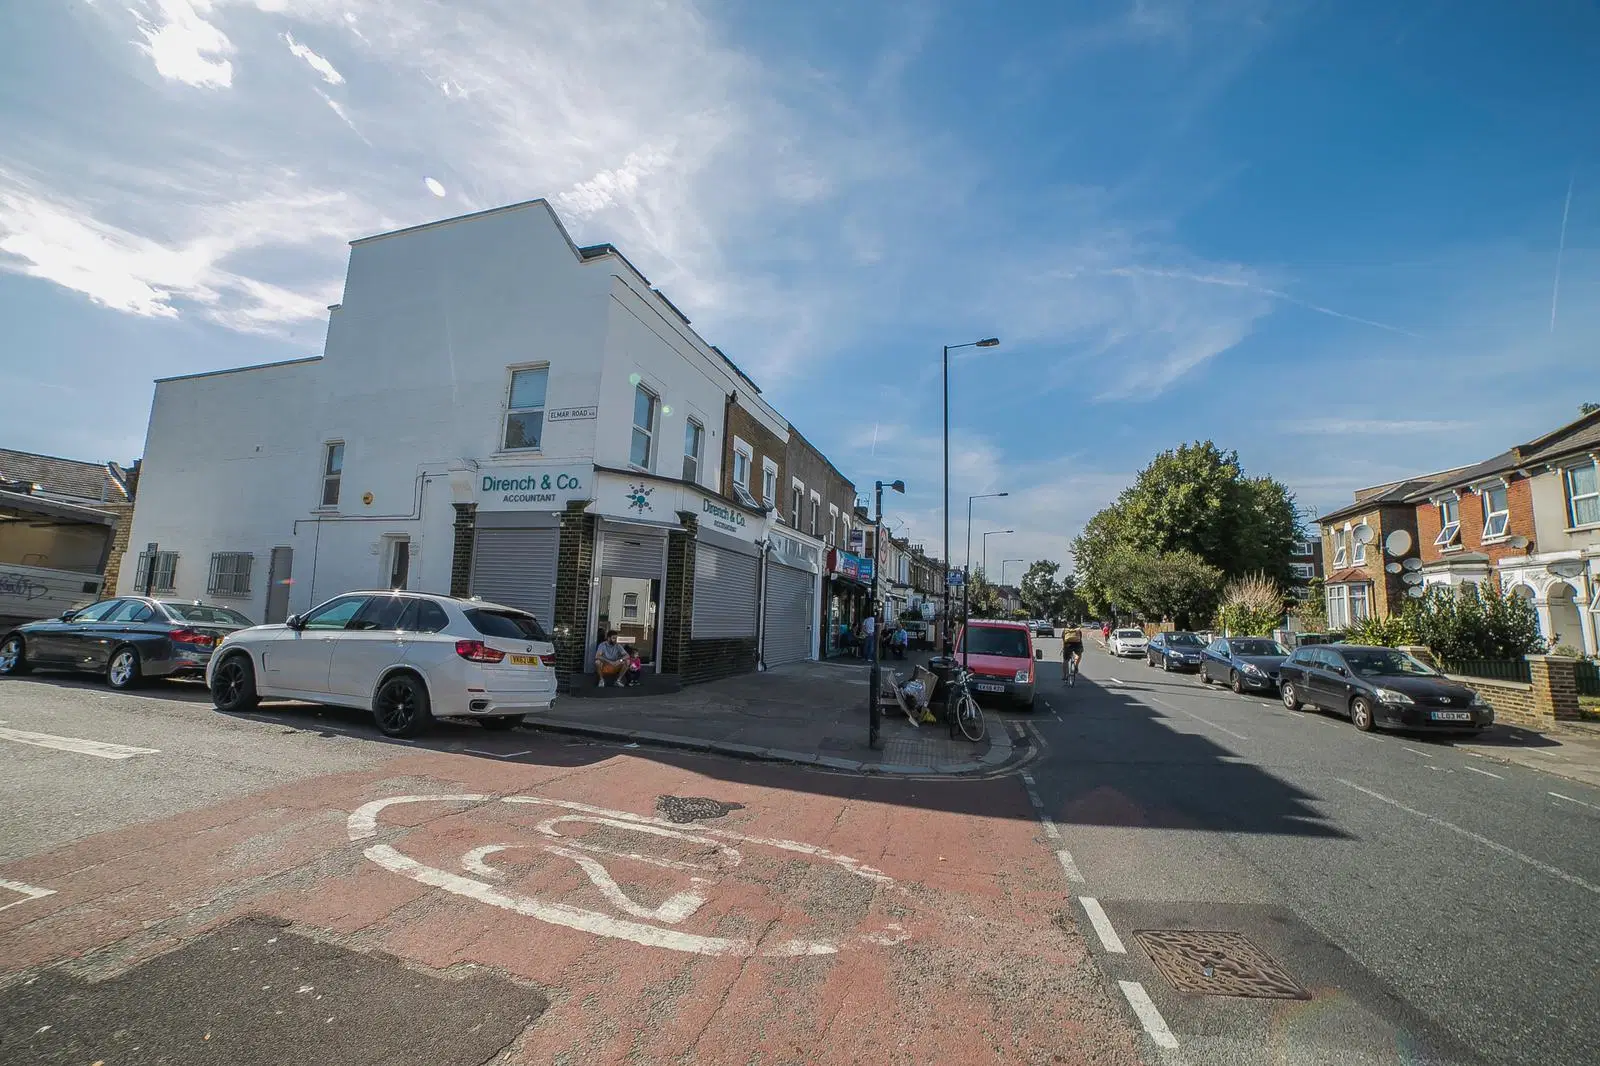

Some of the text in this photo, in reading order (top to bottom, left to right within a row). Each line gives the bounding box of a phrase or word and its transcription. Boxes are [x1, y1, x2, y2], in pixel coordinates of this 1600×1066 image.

[550, 411, 570, 419] ELMAR
[482, 474, 582, 492] Dirench & Co.
[503, 493, 556, 503] ACCOUNTANT
